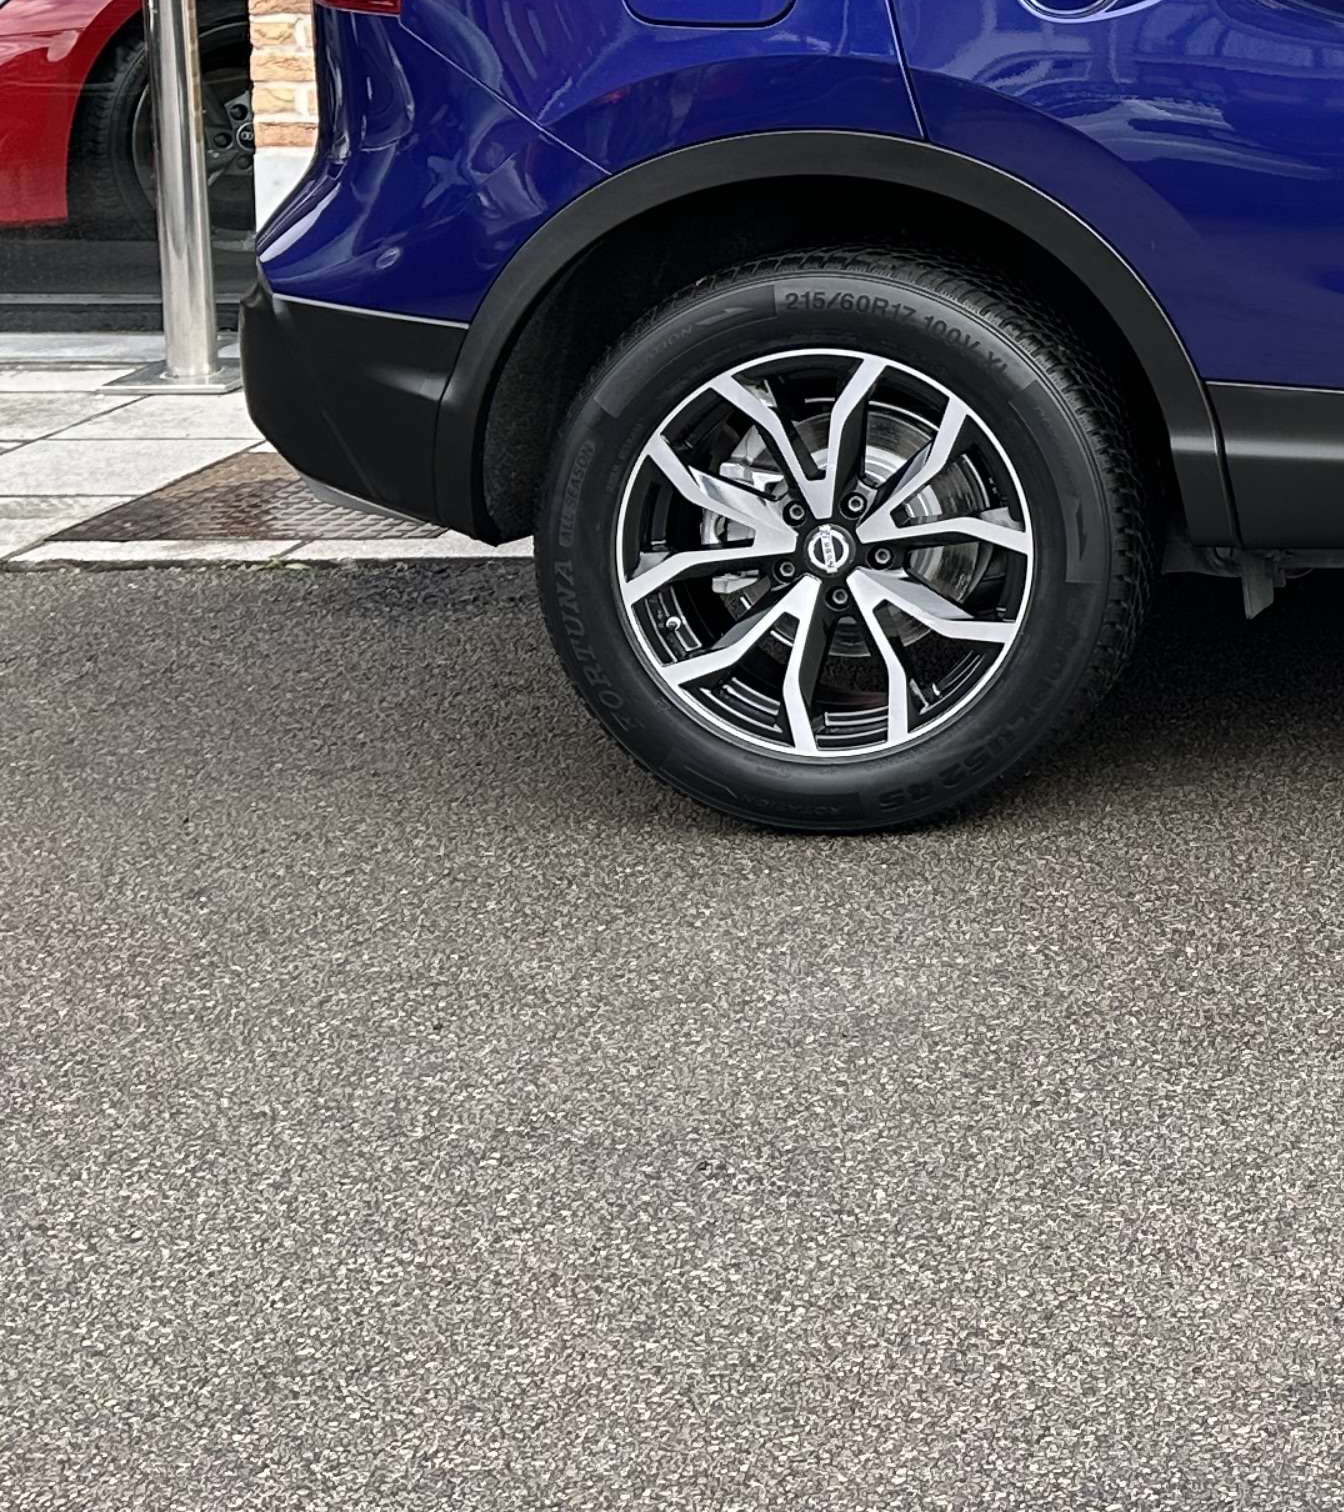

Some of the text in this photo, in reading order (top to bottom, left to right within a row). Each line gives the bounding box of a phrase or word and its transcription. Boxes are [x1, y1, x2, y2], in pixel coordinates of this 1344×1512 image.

[784, 290, 916, 322] 215/60R17
[924, 313, 980, 356] 100V
[554, 558, 644, 735] FORTUNA
